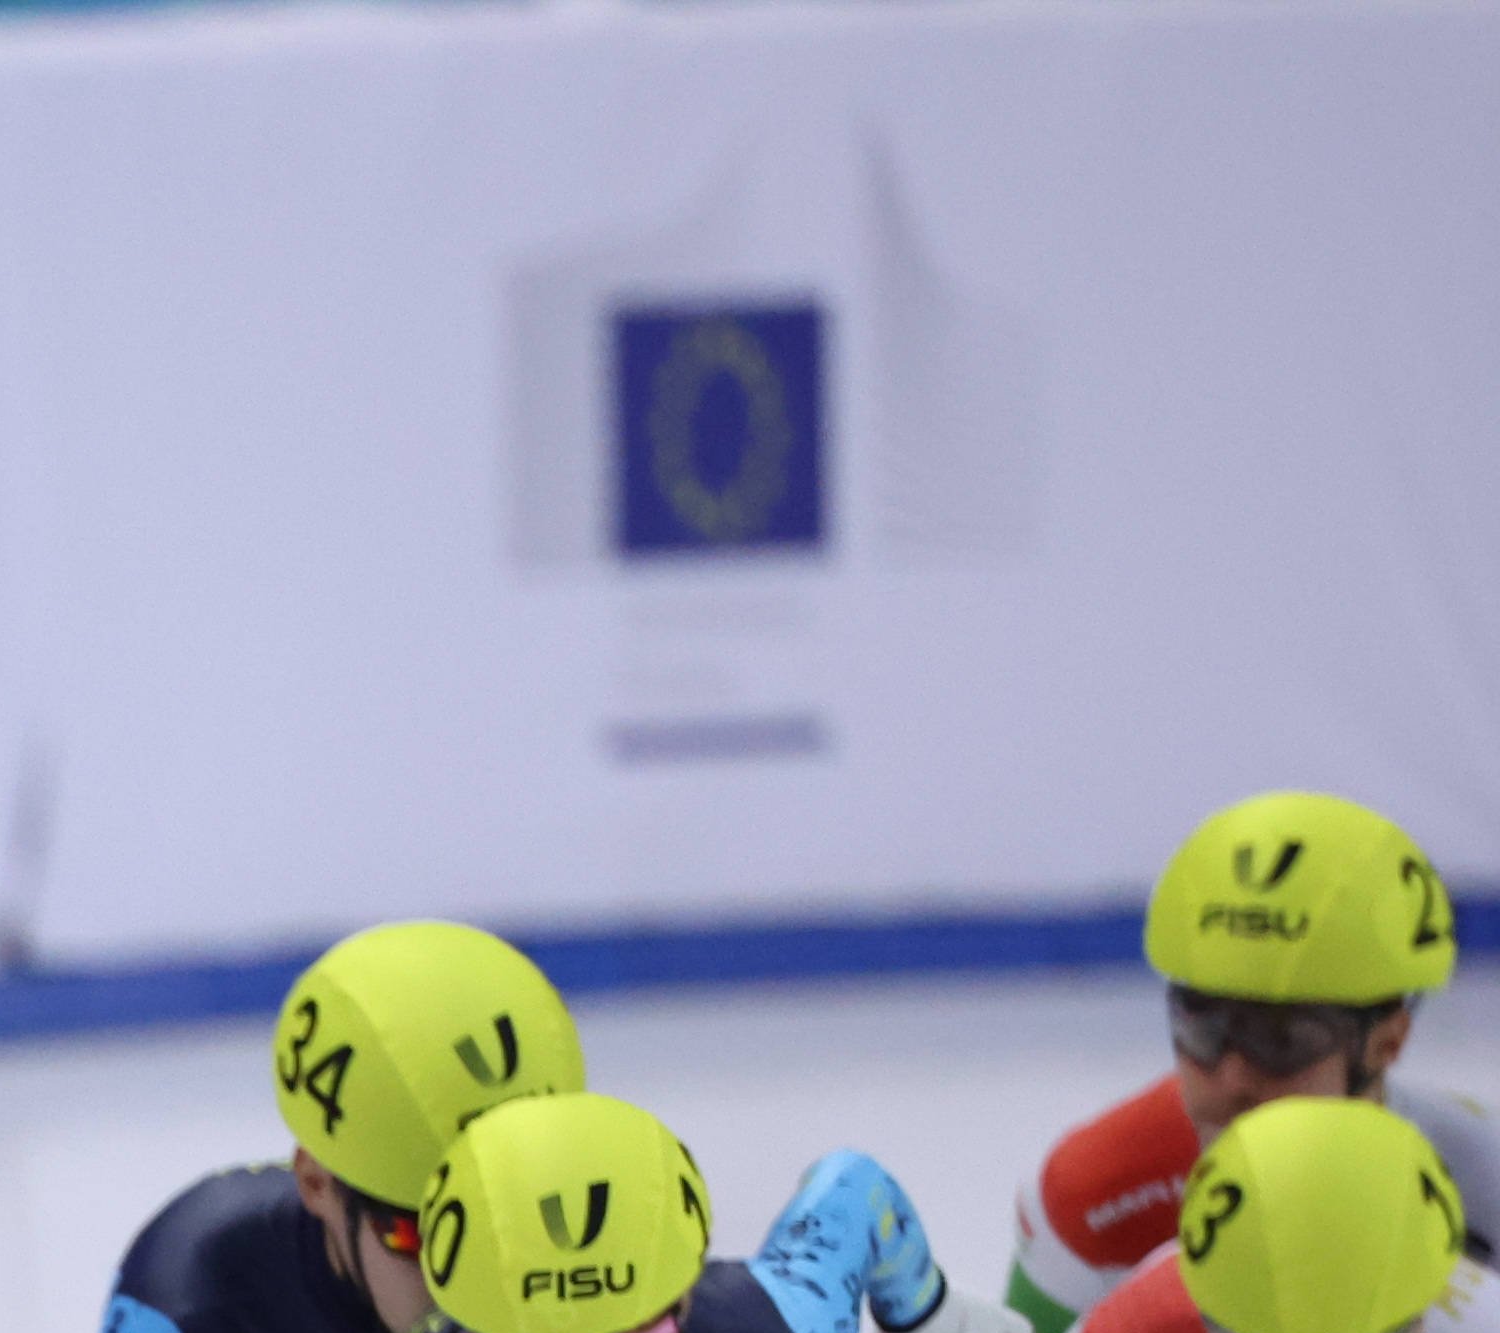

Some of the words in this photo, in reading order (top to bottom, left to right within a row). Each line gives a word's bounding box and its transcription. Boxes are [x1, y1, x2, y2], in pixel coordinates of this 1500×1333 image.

[1400, 856, 1442, 951] 2
[277, 1000, 355, 1135] 34
[1184, 1168, 1243, 1264] 3
[522, 1263, 636, 1302] FISU
